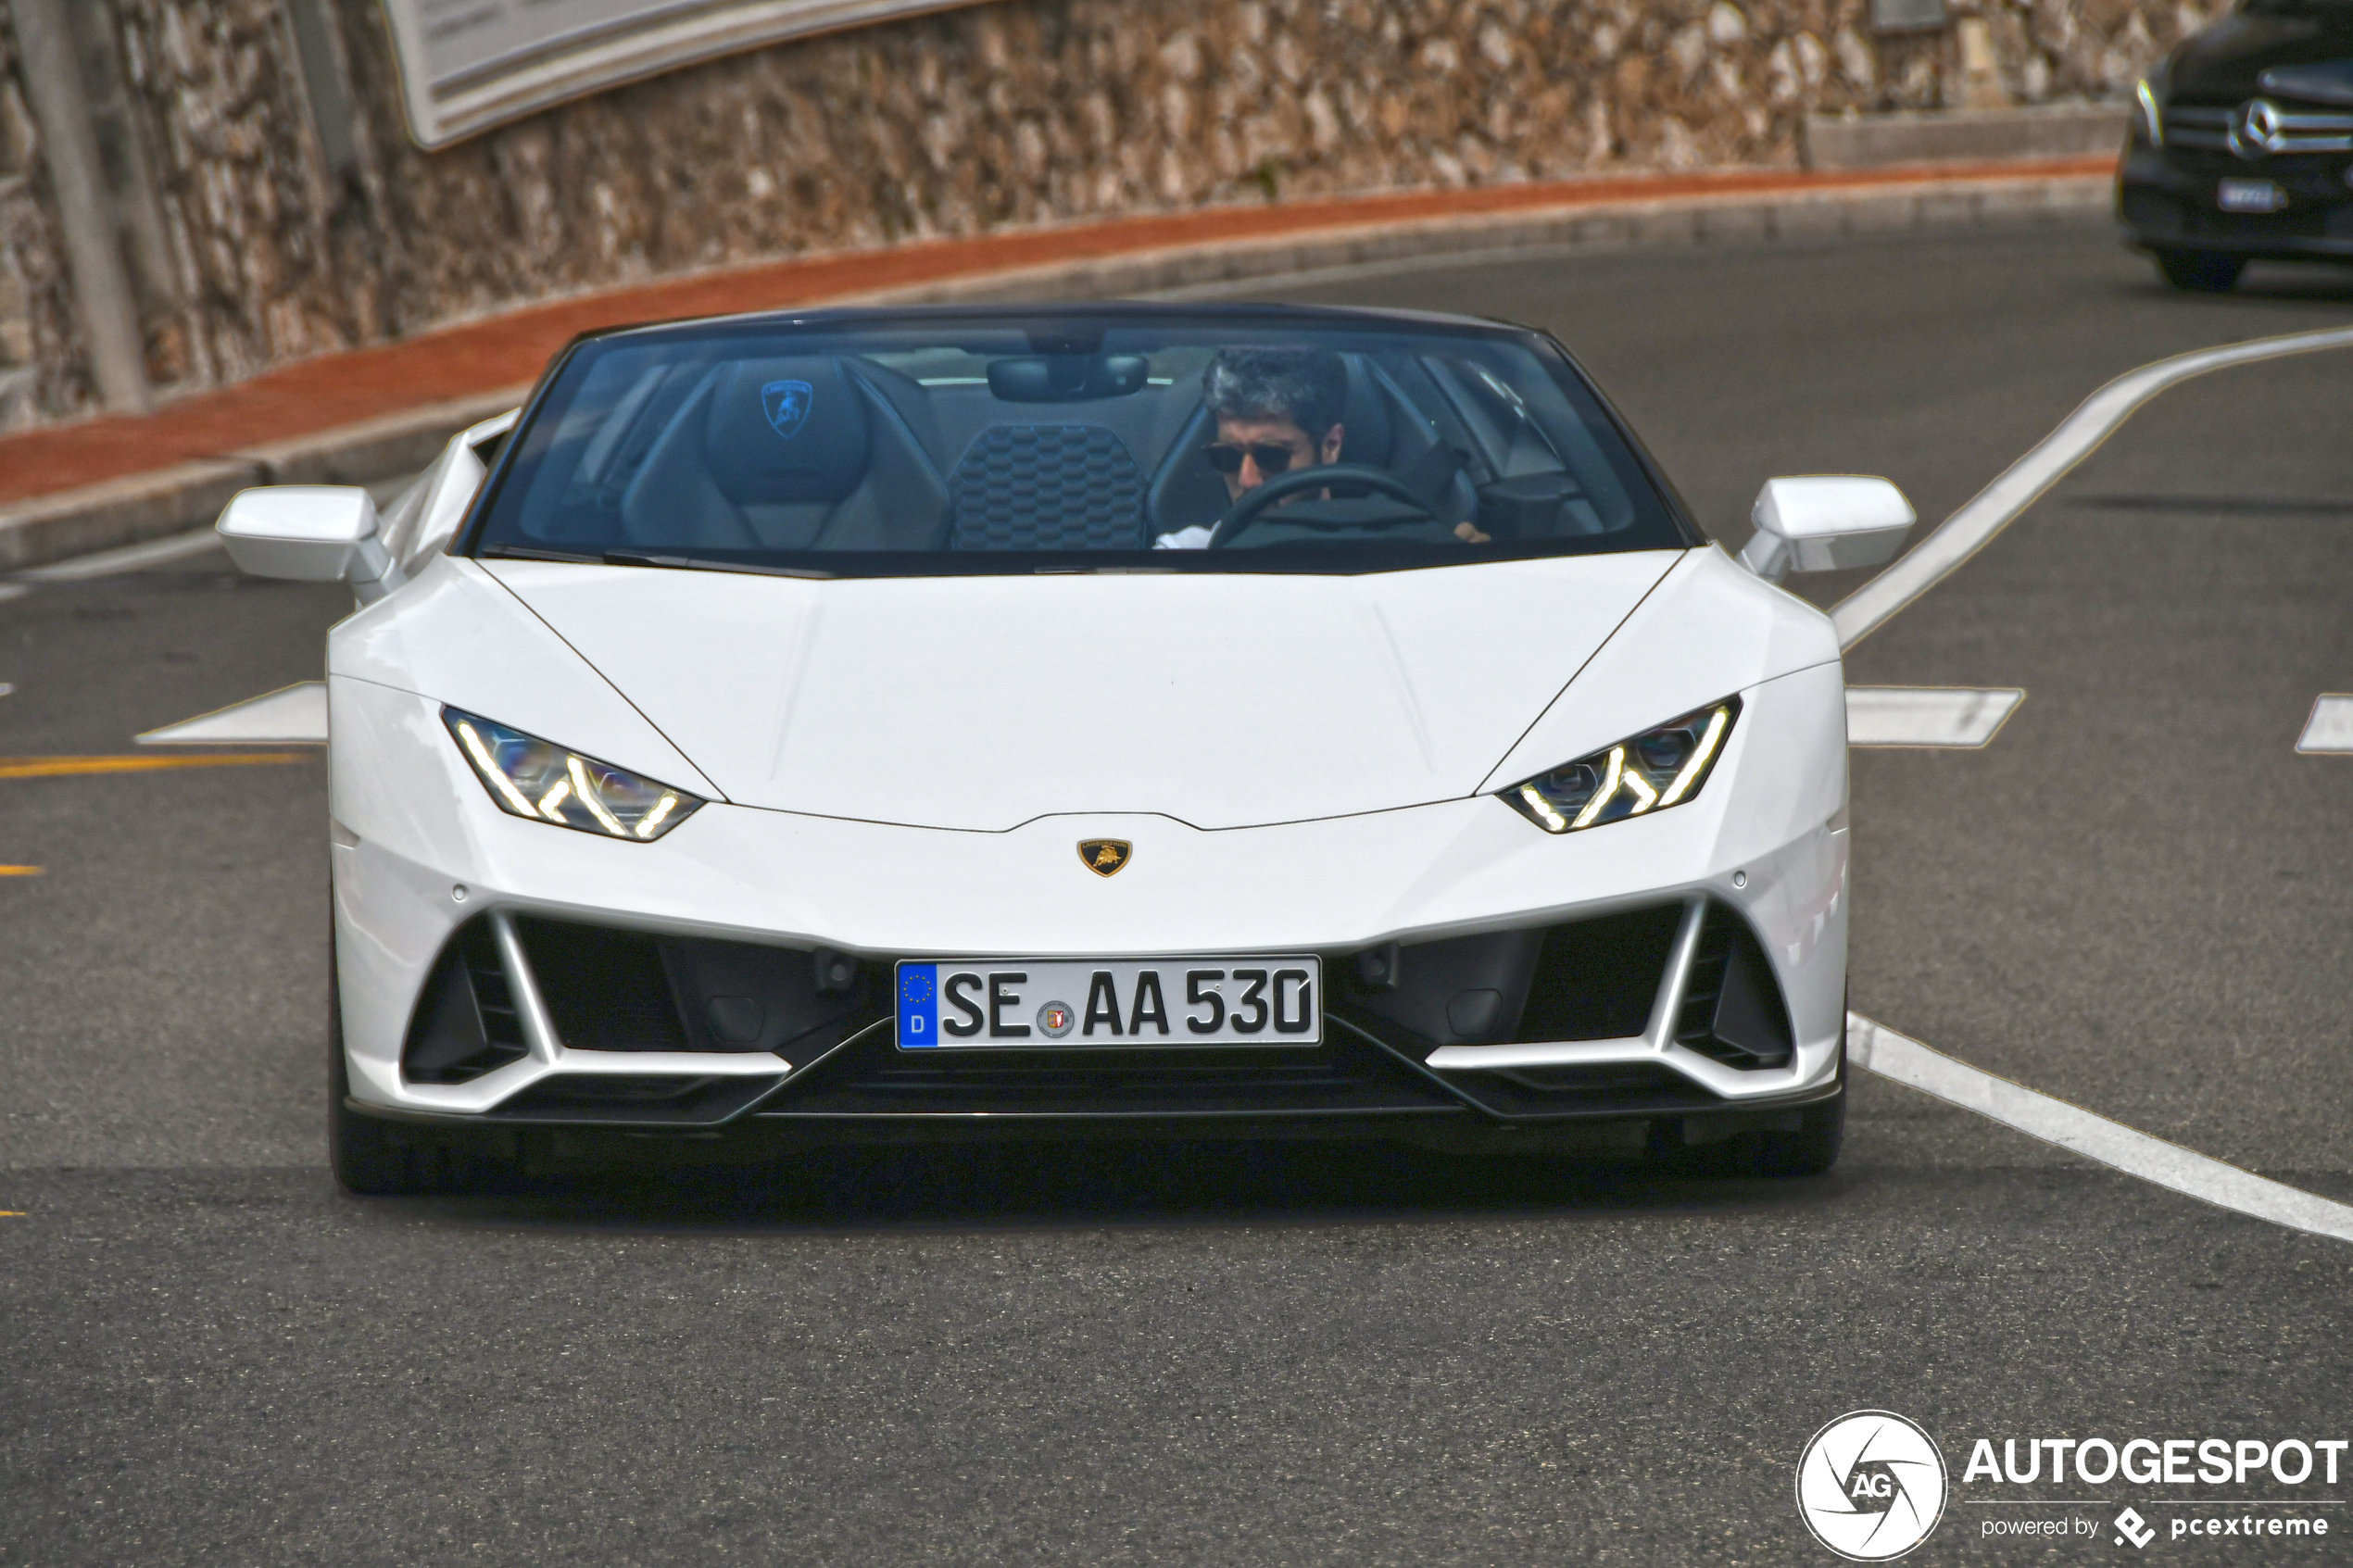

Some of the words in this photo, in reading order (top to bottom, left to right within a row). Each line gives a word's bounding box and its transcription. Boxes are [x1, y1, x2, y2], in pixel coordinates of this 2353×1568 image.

[911, 1015, 925, 1033] D
[943, 972, 1031, 1037] SE
[1081, 970, 1171, 1035] AA
[1186, 969, 1312, 1035] 530
